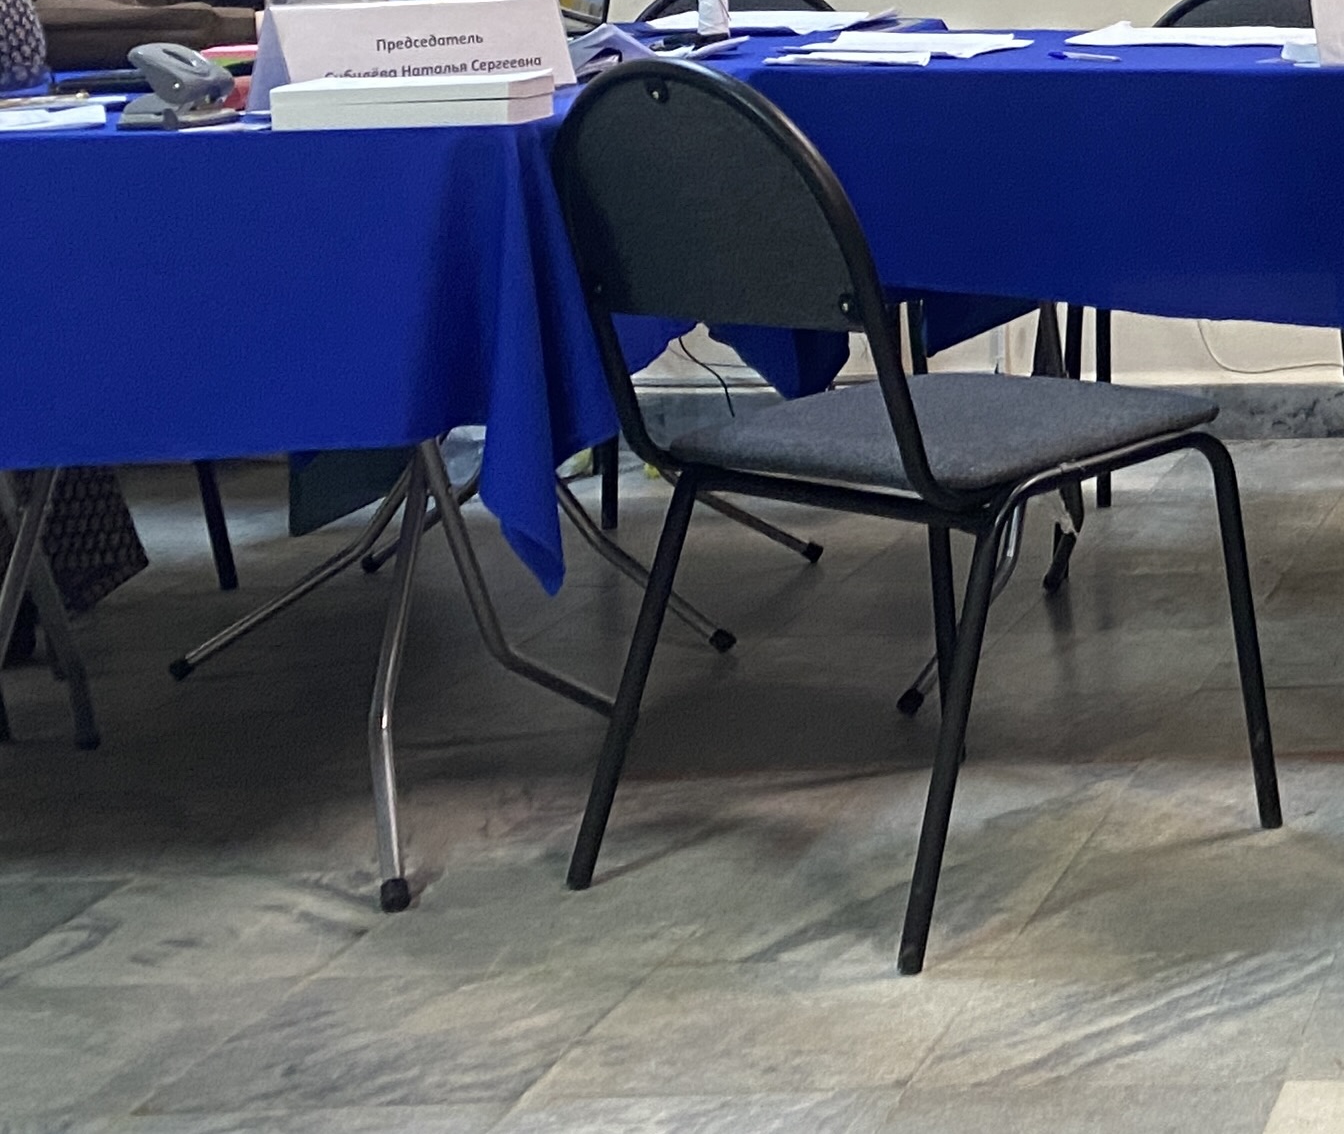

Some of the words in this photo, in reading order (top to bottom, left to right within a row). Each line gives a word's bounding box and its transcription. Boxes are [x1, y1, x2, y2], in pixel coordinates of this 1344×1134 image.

[376, 34, 484, 54] Председатель
[401, 62, 467, 78] Наталья
[471, 56, 542, 72] Сергеевна
